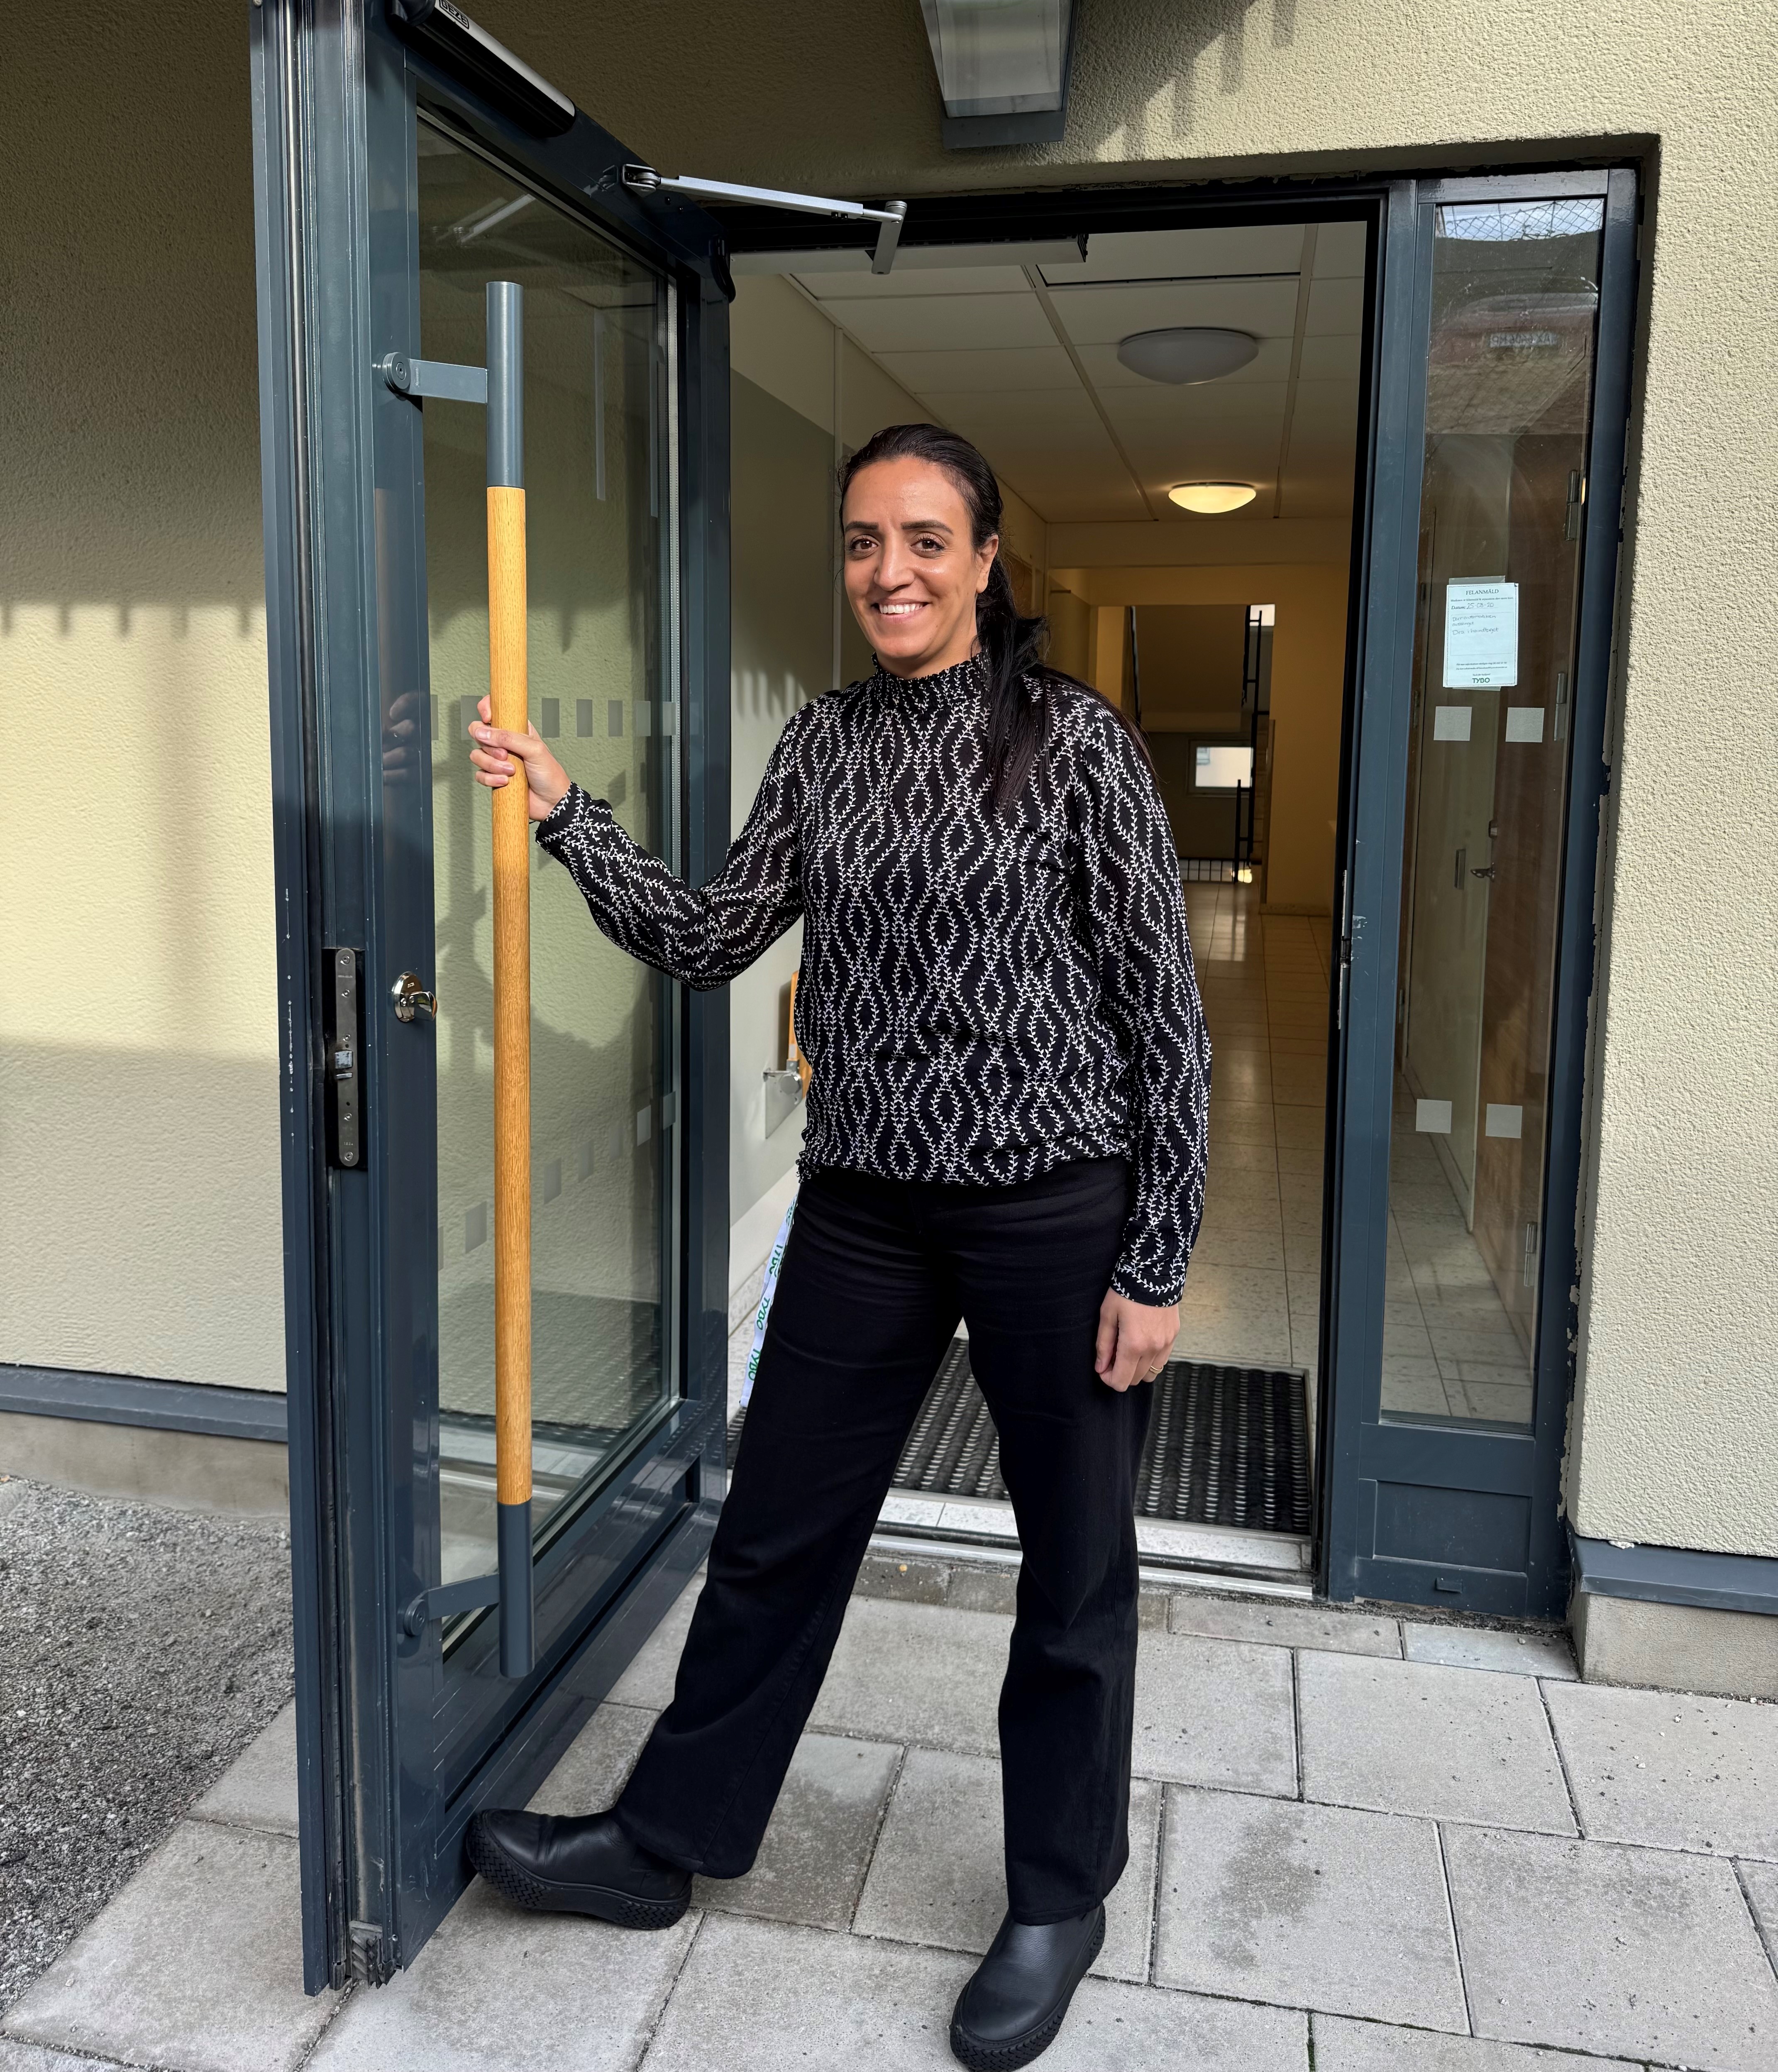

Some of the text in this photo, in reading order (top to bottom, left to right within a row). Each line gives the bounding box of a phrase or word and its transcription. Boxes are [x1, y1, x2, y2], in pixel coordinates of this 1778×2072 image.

[441, 0, 467, 26] GEZE
[757, 1297, 770, 1330] TYBO
[748, 1348, 762, 1381] TYBO
